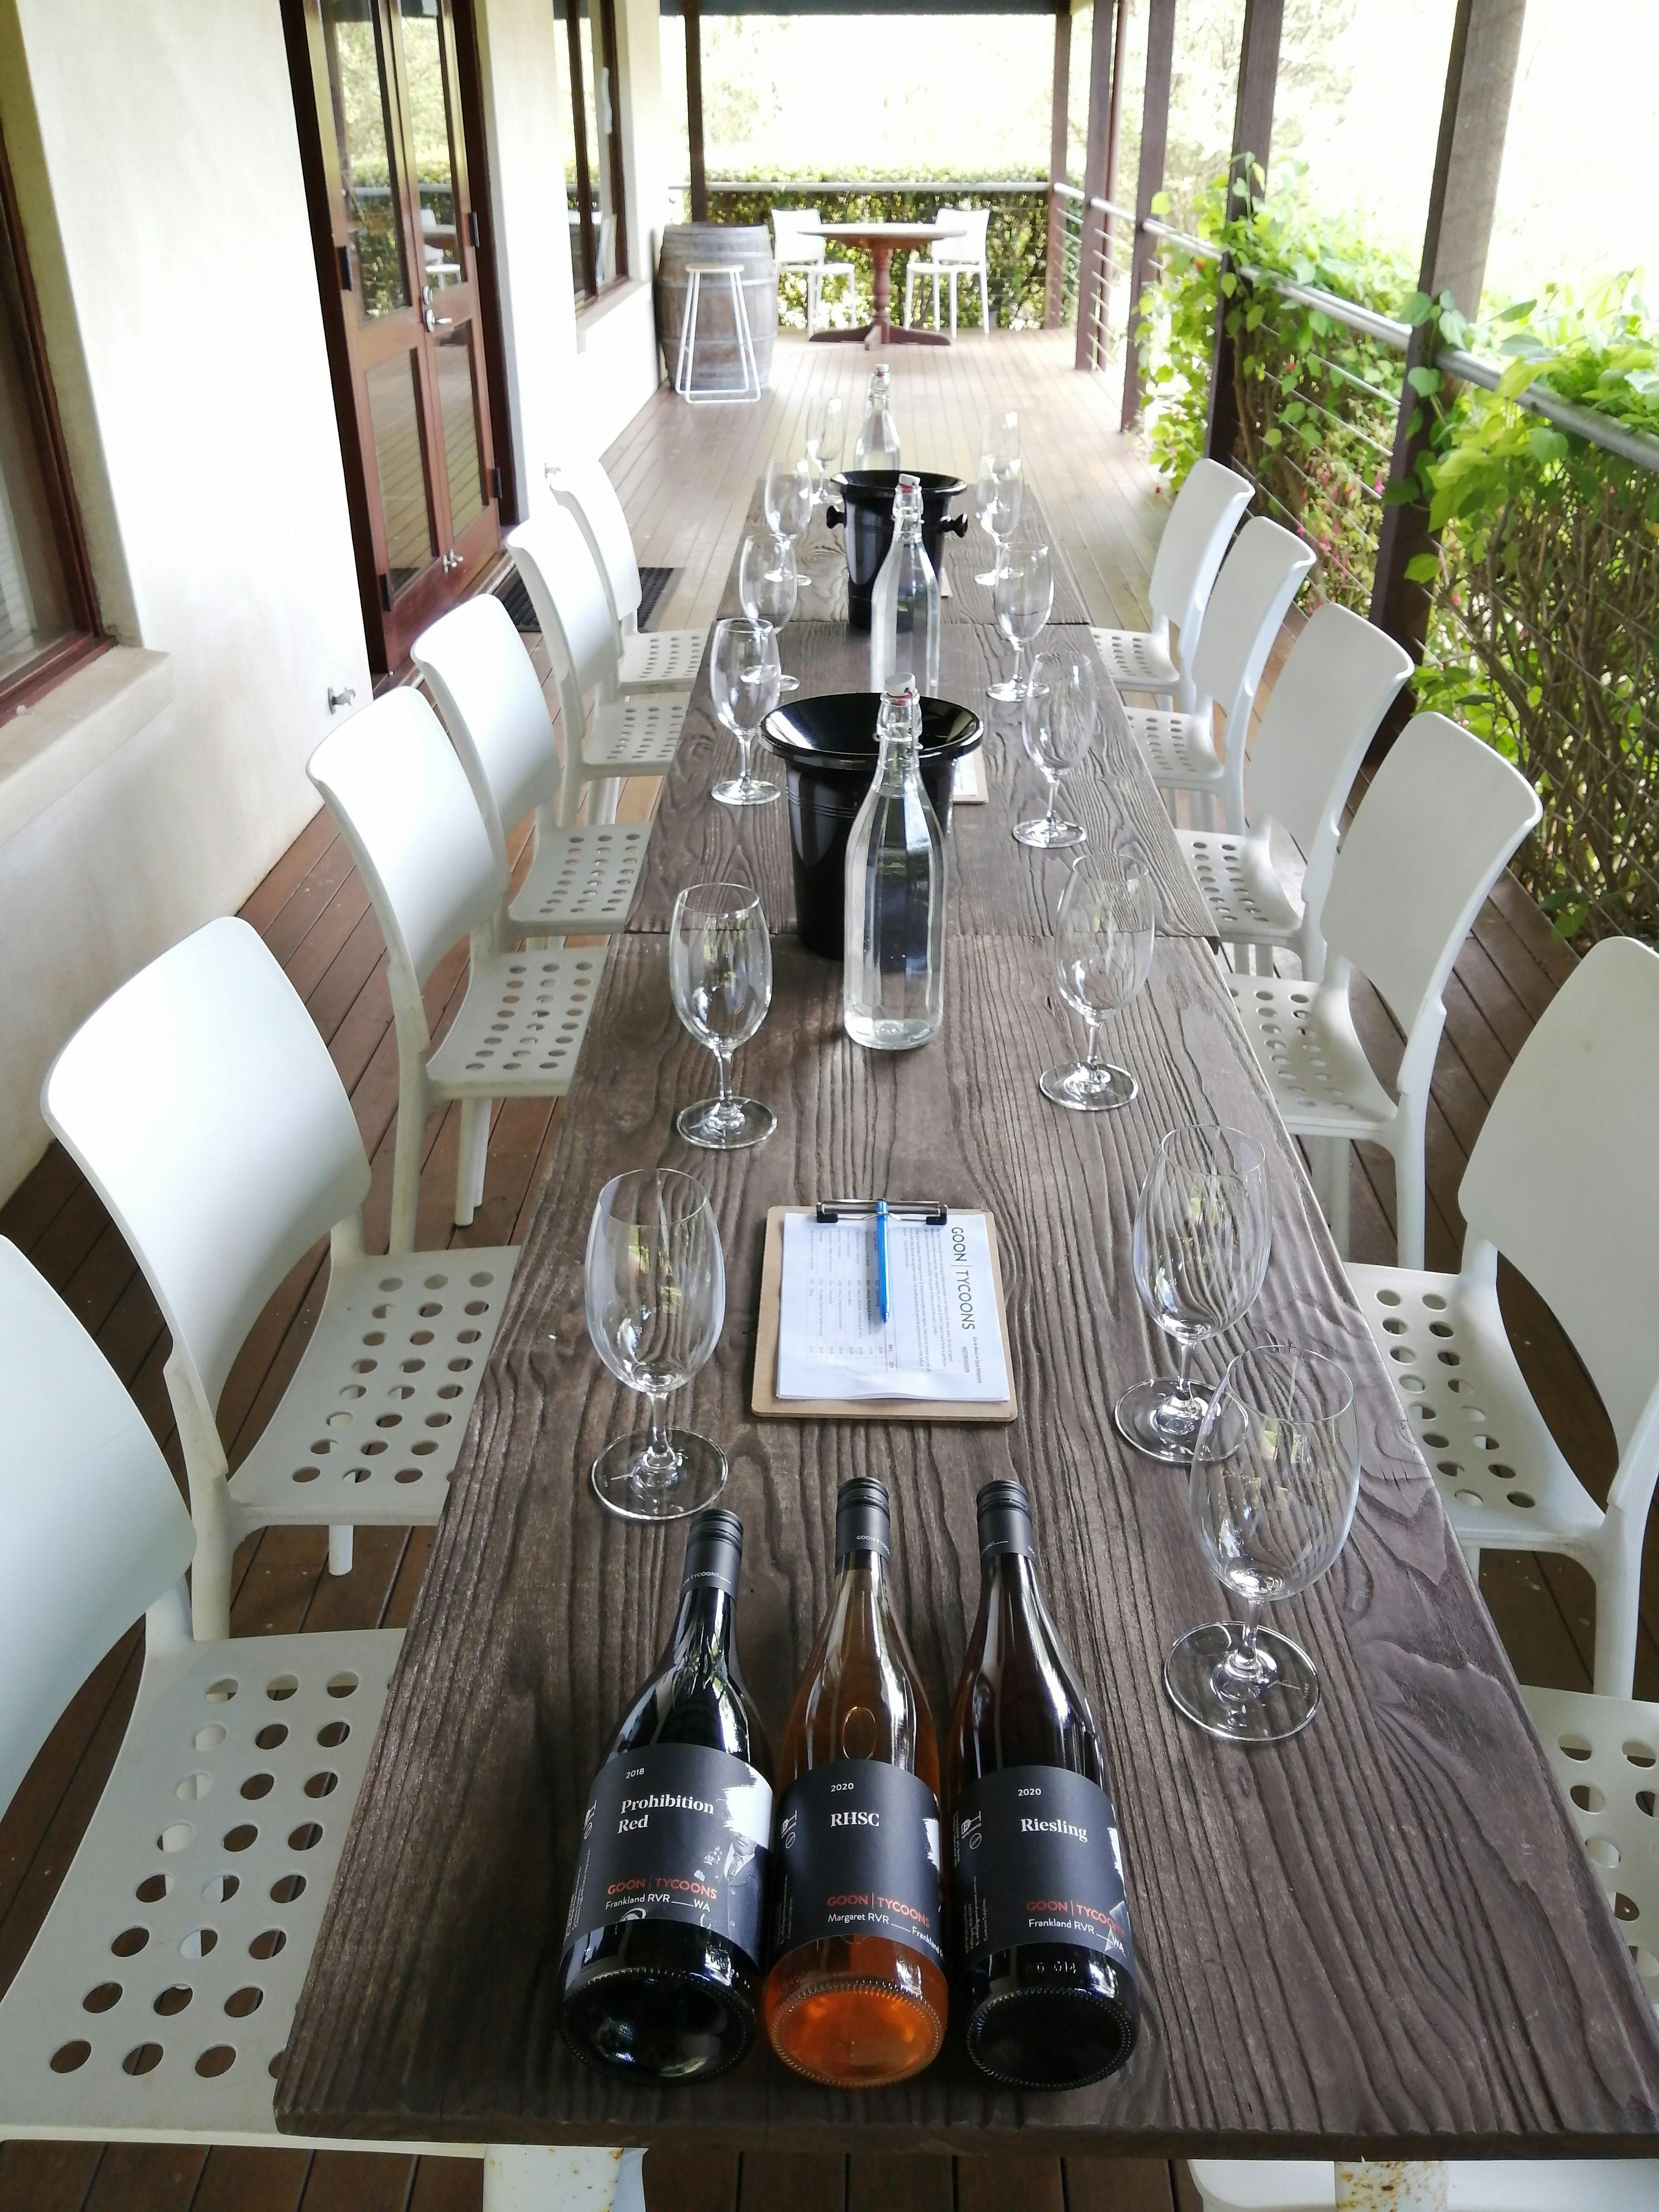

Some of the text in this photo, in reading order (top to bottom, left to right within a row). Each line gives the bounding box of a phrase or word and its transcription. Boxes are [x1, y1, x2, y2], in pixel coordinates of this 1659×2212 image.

[951, 1227, 975, 1330] GOON TYCOONS
[626, 1768, 645, 1779] 2018
[831, 1783, 854, 1792] 2020
[1018, 1788, 1041, 1796] 2020
[621, 1794, 714, 1815] Prohibition
[617, 1814, 648, 1834] Red
[831, 1812, 879, 1827] RHSC
[1020, 1818, 1088, 1843] Riesling
[607, 1877, 717, 1899] GOON TYCOONS
[606, 1893, 710, 1912] Frankland RVR WA
[827, 1895, 930, 1929] GOON TYCOONS
[1026, 1901, 1068, 1912] GOON
[828, 1913, 866, 1923] Margaret
[868, 1913, 889, 1925] RVR
[912, 1926, 939, 1954] Frankland
[1028, 1918, 1125, 1956] Frankland RVR WA
